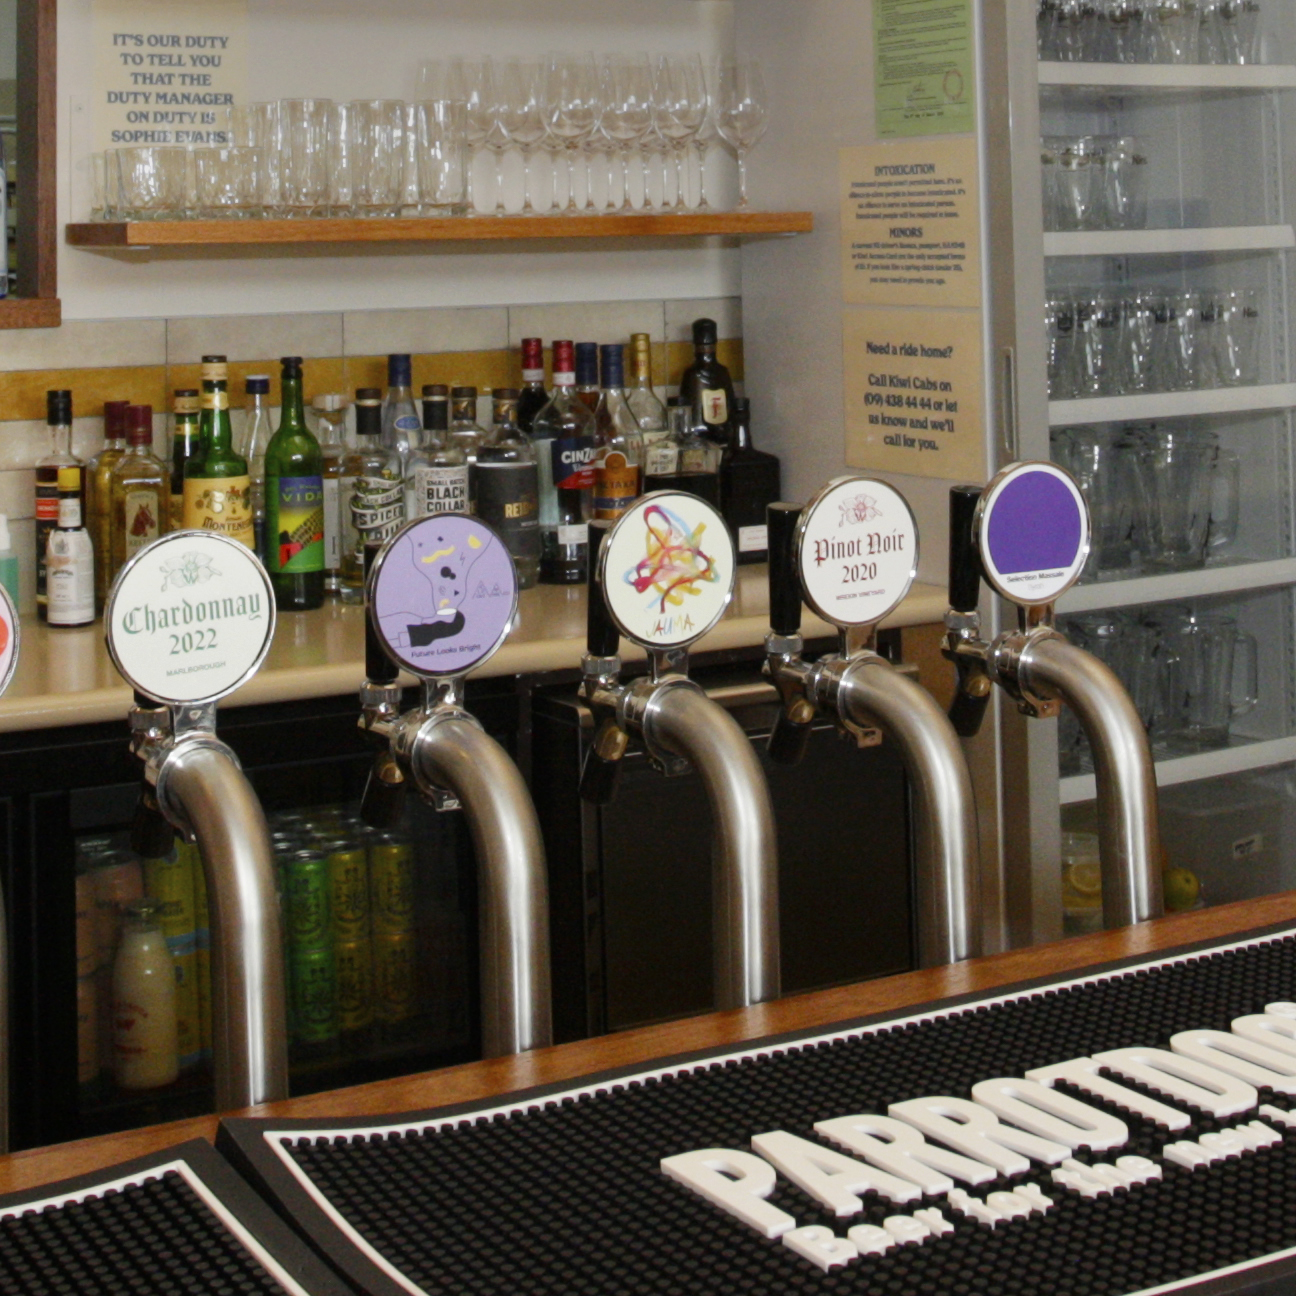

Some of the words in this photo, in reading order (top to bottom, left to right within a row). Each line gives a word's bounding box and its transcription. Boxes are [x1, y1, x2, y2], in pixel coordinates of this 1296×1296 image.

[147, 34, 182, 47] OUR
[185, 36, 229, 49] DUTY
[120, 52, 143, 65] TO
[146, 54, 186, 67] TELL
[189, 54, 222, 67] YOU
[130, 72, 175, 85] THAT
[178, 73, 212, 86] THE
[107, 91, 152, 104] DUTY
[155, 92, 234, 105] MANAGER
[126, 111, 150, 123] ON
[153, 111, 197, 124] DUTY
[200, 111, 216, 124] IS
[111, 130, 172, 143] SOPHIE
[875, 164, 935, 176] INTOXICATION
[889, 227, 923, 238] MINORS
[866, 341, 890, 355] Need
[899, 343, 918, 356] ride
[920, 344, 953, 359] home?
[868, 373, 887, 387] Call
[889, 375, 911, 389] Kiwi
[913, 376, 937, 391] Cabs
[939, 381, 952, 392] on
[864, 392, 883, 407] (09)
[933, 401, 943, 411] or
[945, 399, 958, 413] let
[868, 414, 879, 424] us
[881, 412, 907, 426] know
[909, 417, 928, 430] and
[884, 433, 902, 446] call
[427, 486, 464, 500] BLACK
[814, 536, 862, 567] Pinot
[866, 528, 905, 556] Noir
[842, 562, 877, 584] 2020
[122, 593, 262, 635] Chardonnay
[646, 613, 695, 638] JAUMA
[169, 628, 218, 655] 2022
[411, 650, 435, 658] Future
[437, 647, 457, 655] Looks
[166, 661, 226, 677] MARLBOROUGH
[782, 1207, 954, 1273] Beer
[947, 1182, 1054, 1230] for
[1051, 1155, 1163, 1198] the
[1163, 1120, 1282, 1171] new
